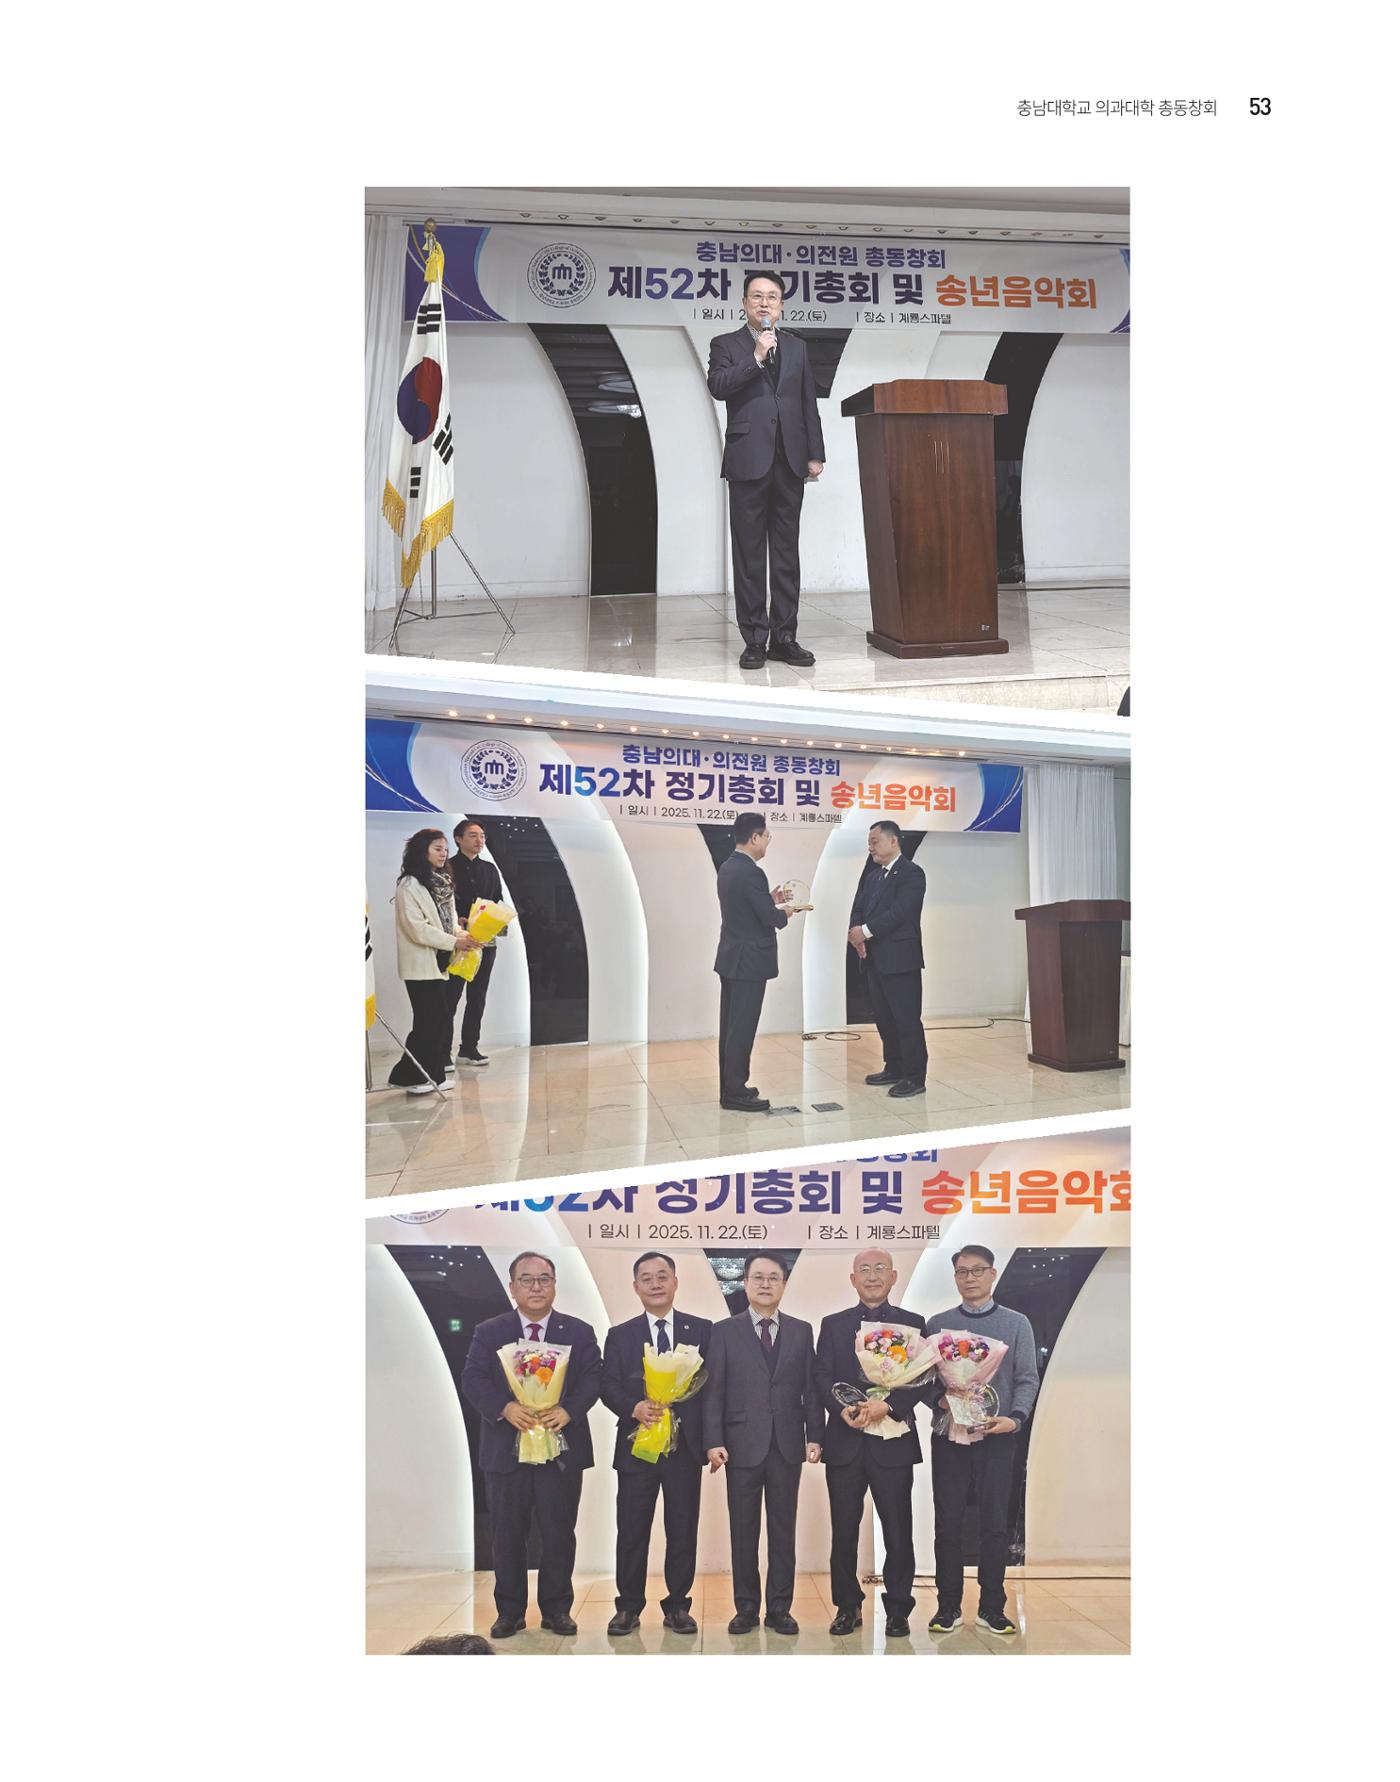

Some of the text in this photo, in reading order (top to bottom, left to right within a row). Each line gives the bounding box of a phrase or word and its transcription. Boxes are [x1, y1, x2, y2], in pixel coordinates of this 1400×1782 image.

[1017, 99, 1217, 116] 충남대학교 의과대학 총동창회
[1249, 97, 1272, 116] 53
[696, 241, 946, 269] 충남의대·의전원 총동창회
[608, 265, 732, 301] 제52차
[744, 269, 880, 305] 기총회
[893, 273, 924, 305] 및
[936, 274, 1097, 309] 송년음악회
[702, 308, 724, 321] 일시
[864, 311, 886, 324] 장소
[622, 744, 841, 777] 충남의대·의전원 총동창회
[539, 763, 655, 799] 제52차
[666, 771, 784, 806] 정기총회
[795, 779, 820, 807] 및
[831, 780, 956, 813] 송년음악회
[628, 804, 649, 816] 일시
[661, 807, 691, 818] 2025.
[770, 811, 788, 823] 장소
[861, 1170, 903, 1215] 및
[599, 1224, 629, 1240] 일시
[648, 1225, 694, 1240] 2025.
[818, 1224, 849, 1241] 장소
[866, 1224, 941, 1241] 계룡스파텔
